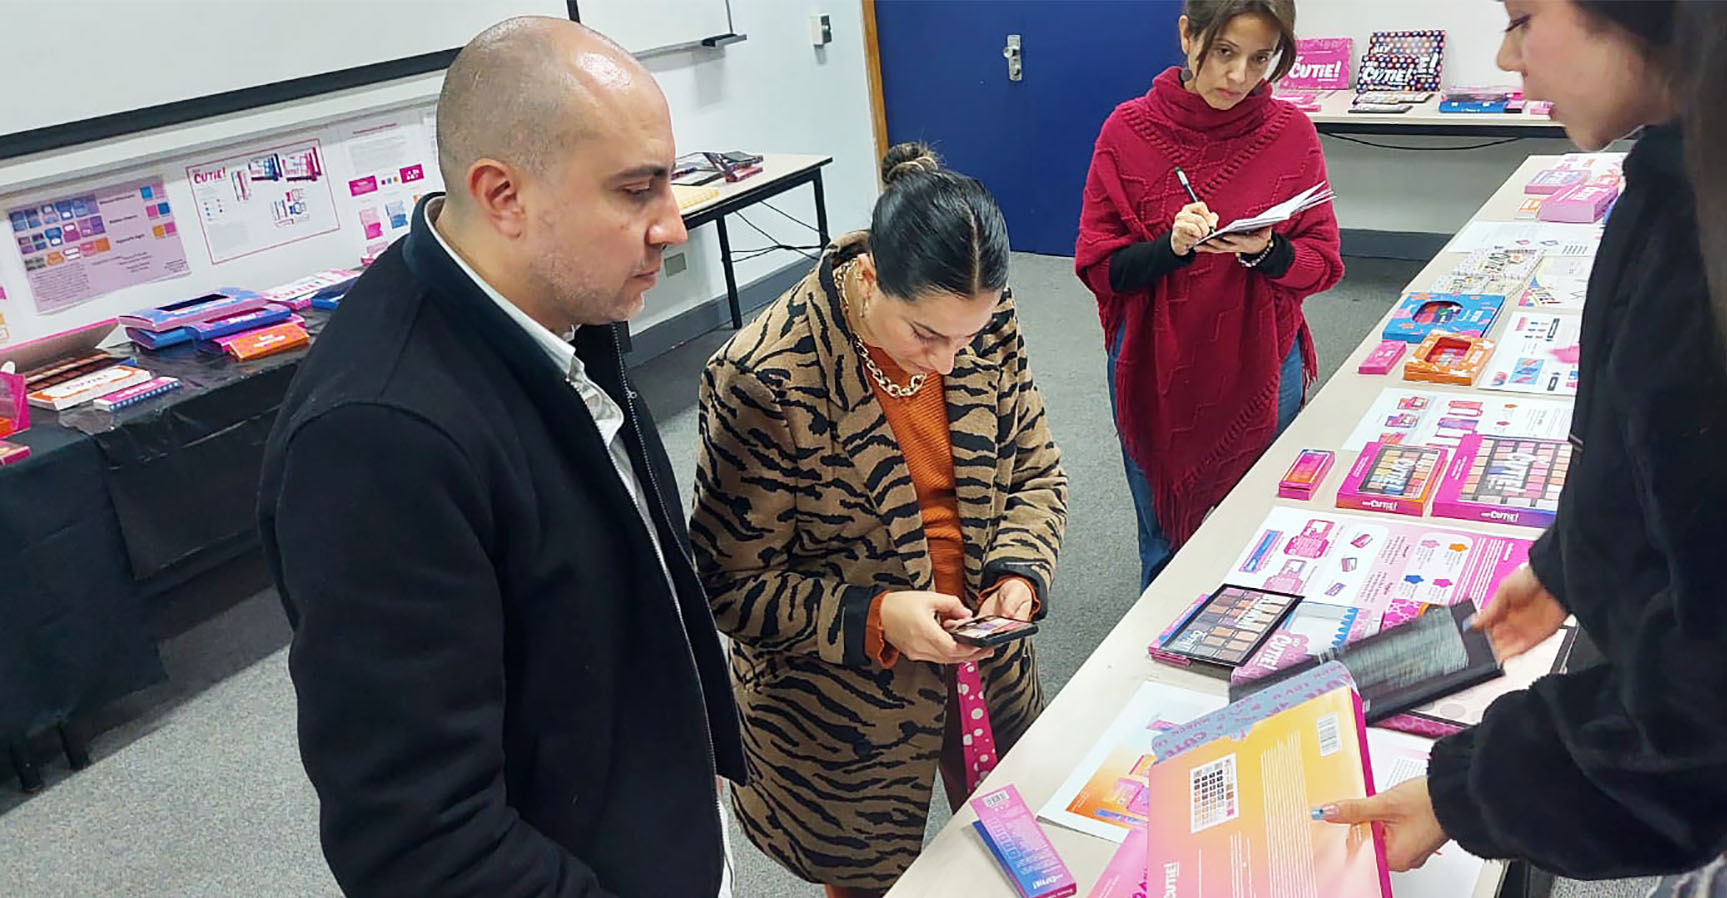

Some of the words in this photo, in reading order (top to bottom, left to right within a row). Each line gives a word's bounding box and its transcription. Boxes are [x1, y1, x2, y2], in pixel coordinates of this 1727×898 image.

[1288, 60, 1342, 79] CUTIE!
[1362, 67, 1413, 83] CUTIE!
[193, 166, 226, 184] CUTIE!
[1259, 634, 1293, 671] CUTIE!
